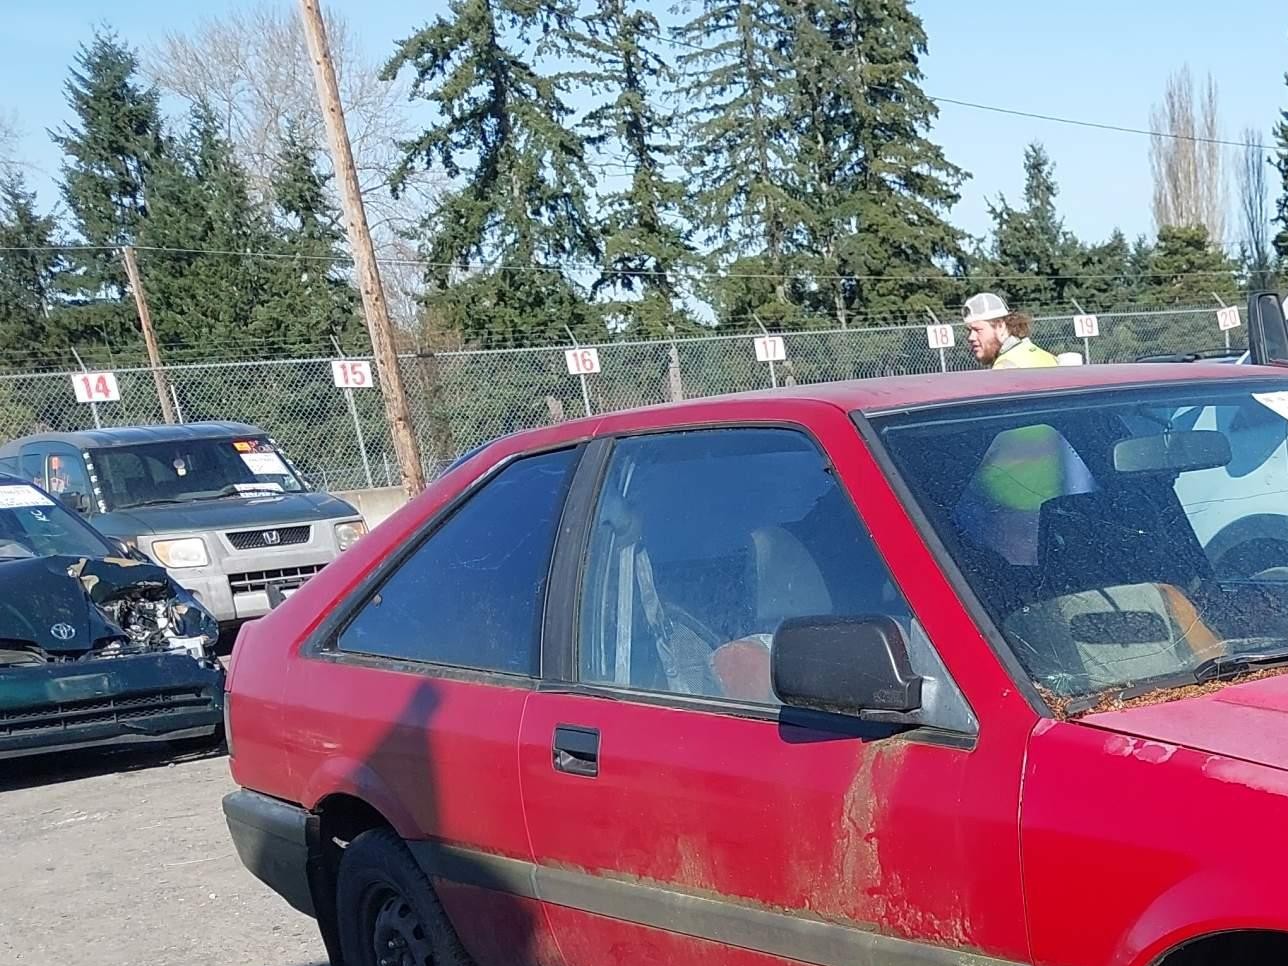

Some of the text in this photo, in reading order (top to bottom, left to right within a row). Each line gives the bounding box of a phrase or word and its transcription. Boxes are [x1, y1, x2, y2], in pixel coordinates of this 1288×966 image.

[1079, 317, 1094, 335] 19
[1220, 309, 1237, 328] 20
[932, 327, 949, 346] 18
[762, 339, 777, 359] 17
[572, 350, 594, 372] 16
[339, 362, 366, 386] 15
[81, 375, 111, 400] 14
